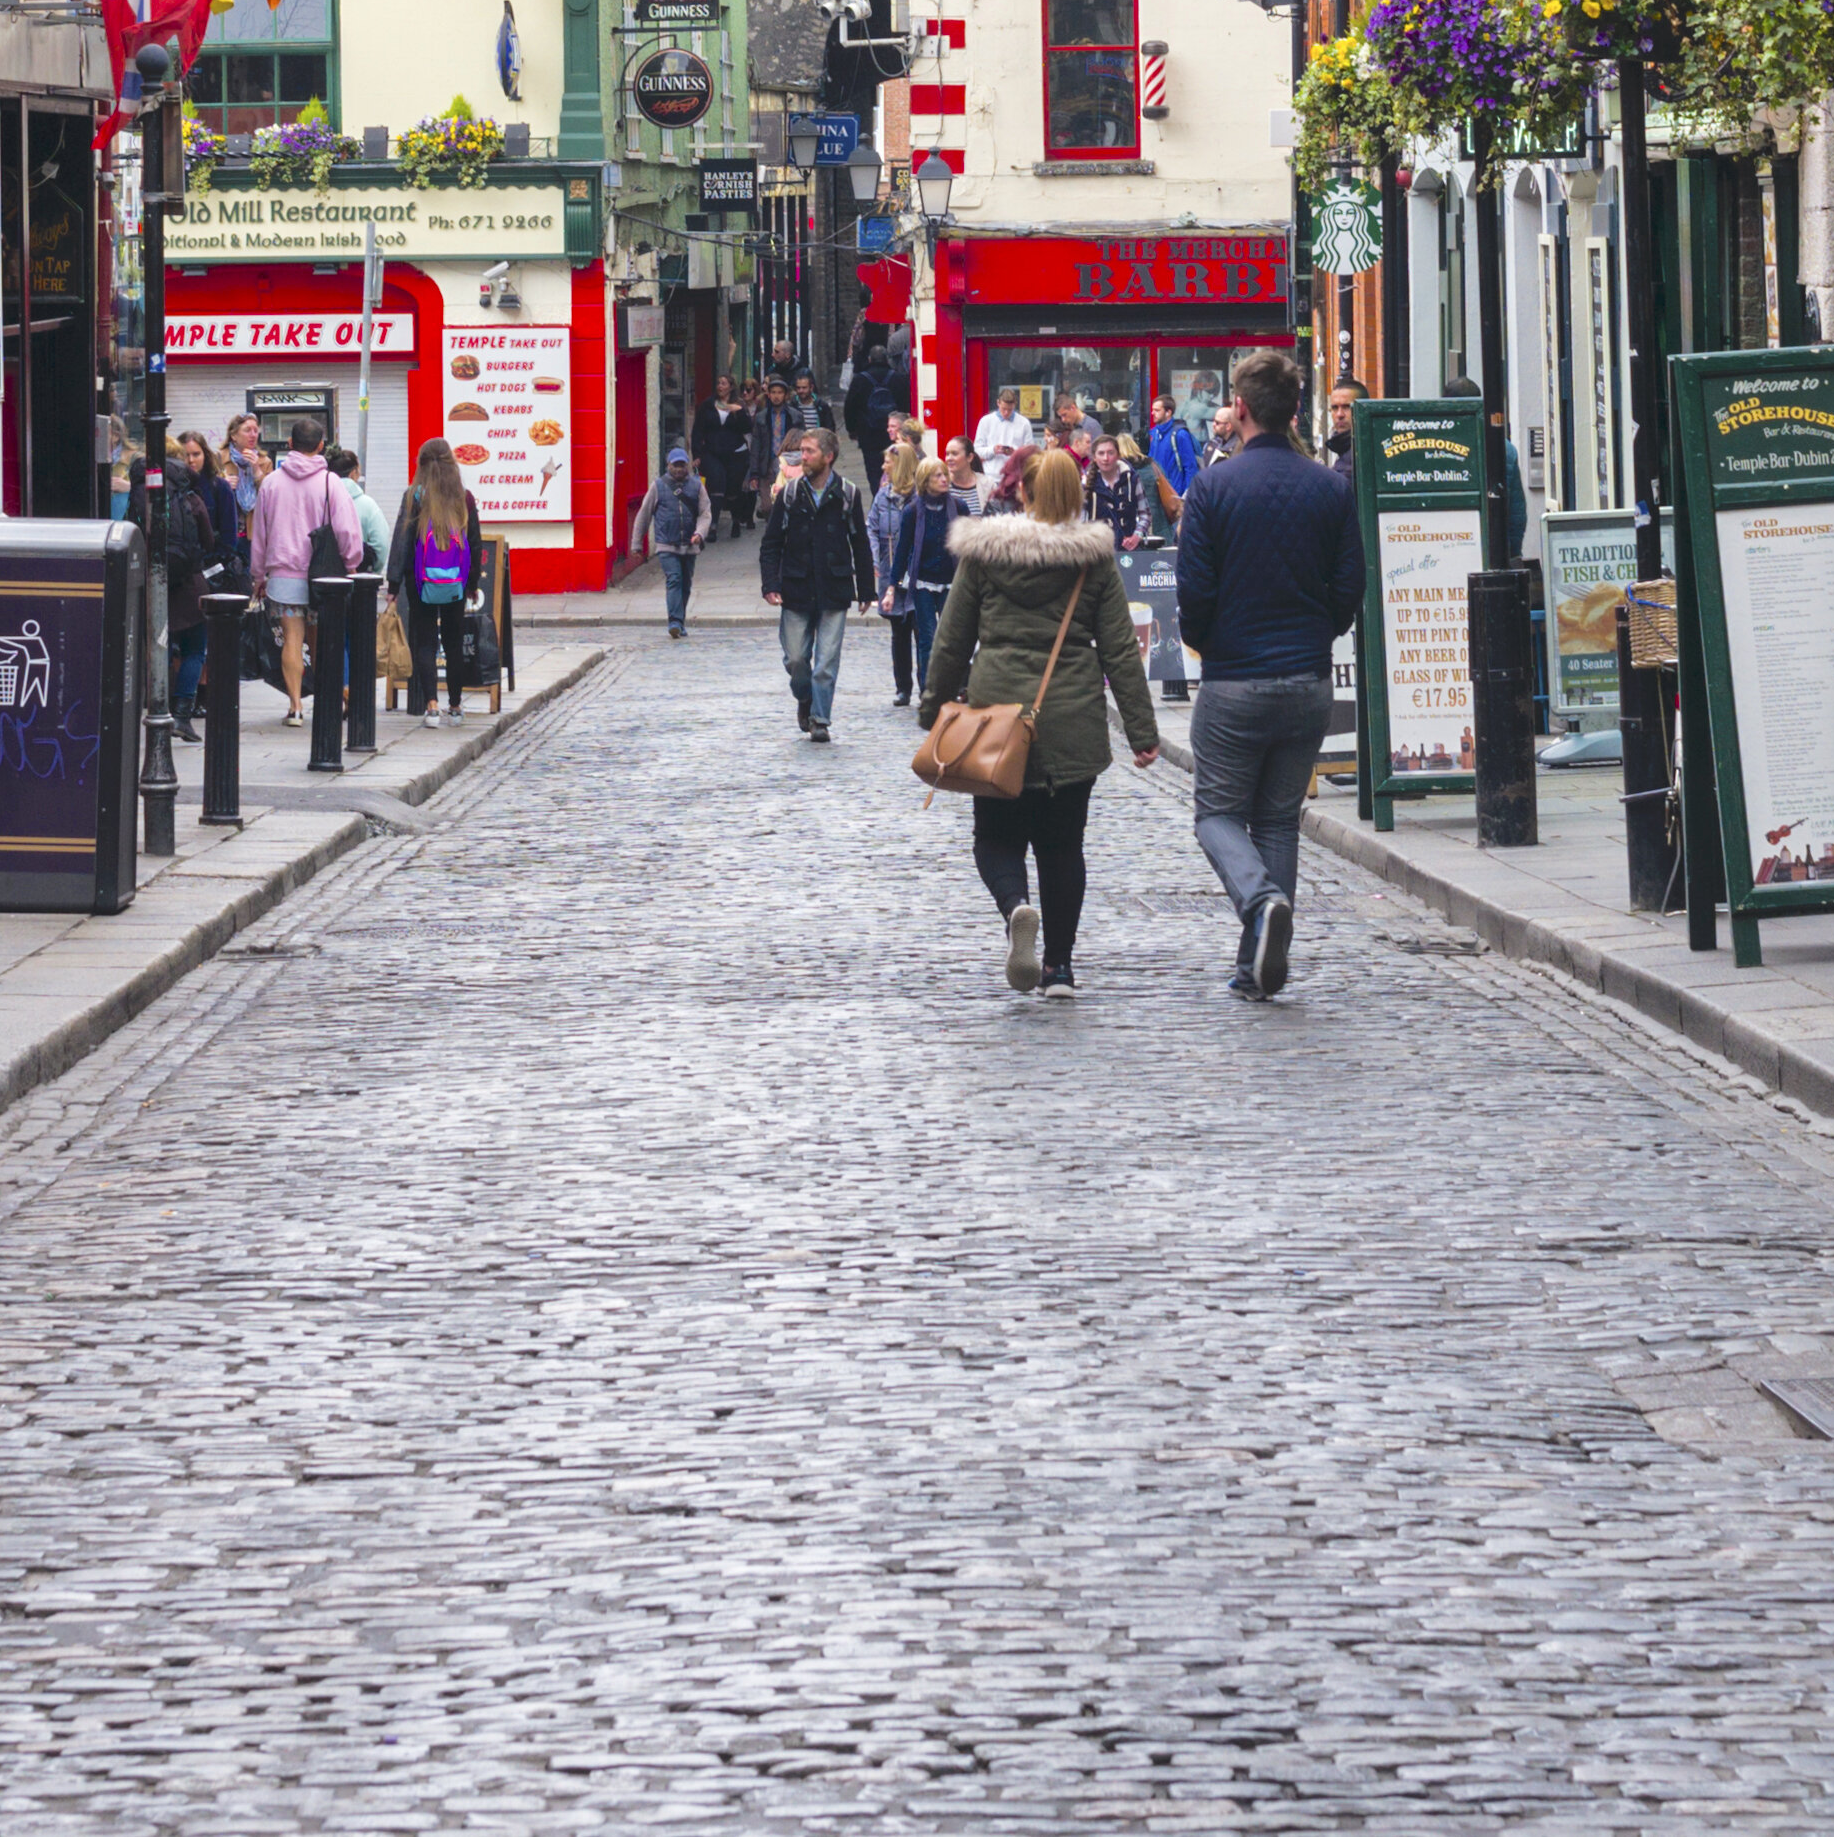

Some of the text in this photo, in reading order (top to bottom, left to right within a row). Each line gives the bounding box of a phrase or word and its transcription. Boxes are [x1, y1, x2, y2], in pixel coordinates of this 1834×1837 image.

[648, 4, 710, 18] GUINNESS
[639, 75, 707, 92] GUINNESS
[704, 171, 753, 181] HANLEY'S
[704, 190, 753, 199] PASTIES
[219, 199, 494, 230] Mill Restaurant Ph: 671
[246, 231, 361, 249] Modern Irish
[1097, 239, 1286, 261] THE MERCHA
[250, 323, 323, 348] TAKE
[450, 337, 563, 349] TEMPLE TAKE OUT
[486, 362, 535, 371] BURGERS
[477, 383, 527, 393] HOT DOGS
[1732, 376, 1820, 394] Welcome to
[493, 405, 533, 414] KEBABS
[1729, 397, 1761, 414] OLD
[1392, 419, 1454, 431] Welcome to
[1763, 426, 1779, 438] Bar
[487, 429, 517, 439] CHIPS
[1392, 431, 1415, 444] OLD
[1383, 438, 1470, 459] STOREHOUSE
[498, 451, 527, 461] PIZZA
[1726, 453, 1791, 474] Temple Bar
[479, 474, 534, 484] ICE CREAM
[1385, 469, 1462, 486] Temple Bar Dublin
[482, 500, 548, 510] TEA COFFEE
[1397, 524, 1421, 533] OLD
[1753, 518, 1778, 528] OLD
[1387, 532, 1473, 543] STOREHOUSE
[1743, 524, 1834, 540] STOREHOUSE
[1563, 565, 1599, 583] FISH
[1388, 588, 1443, 603] ANY MAIN
[1397, 609, 1429, 623] UP TO
[1396, 628, 1458, 643] WITH PINT
[1400, 649, 1456, 664] ANY BEER
[1393, 669, 1449, 684] GLASS OF
